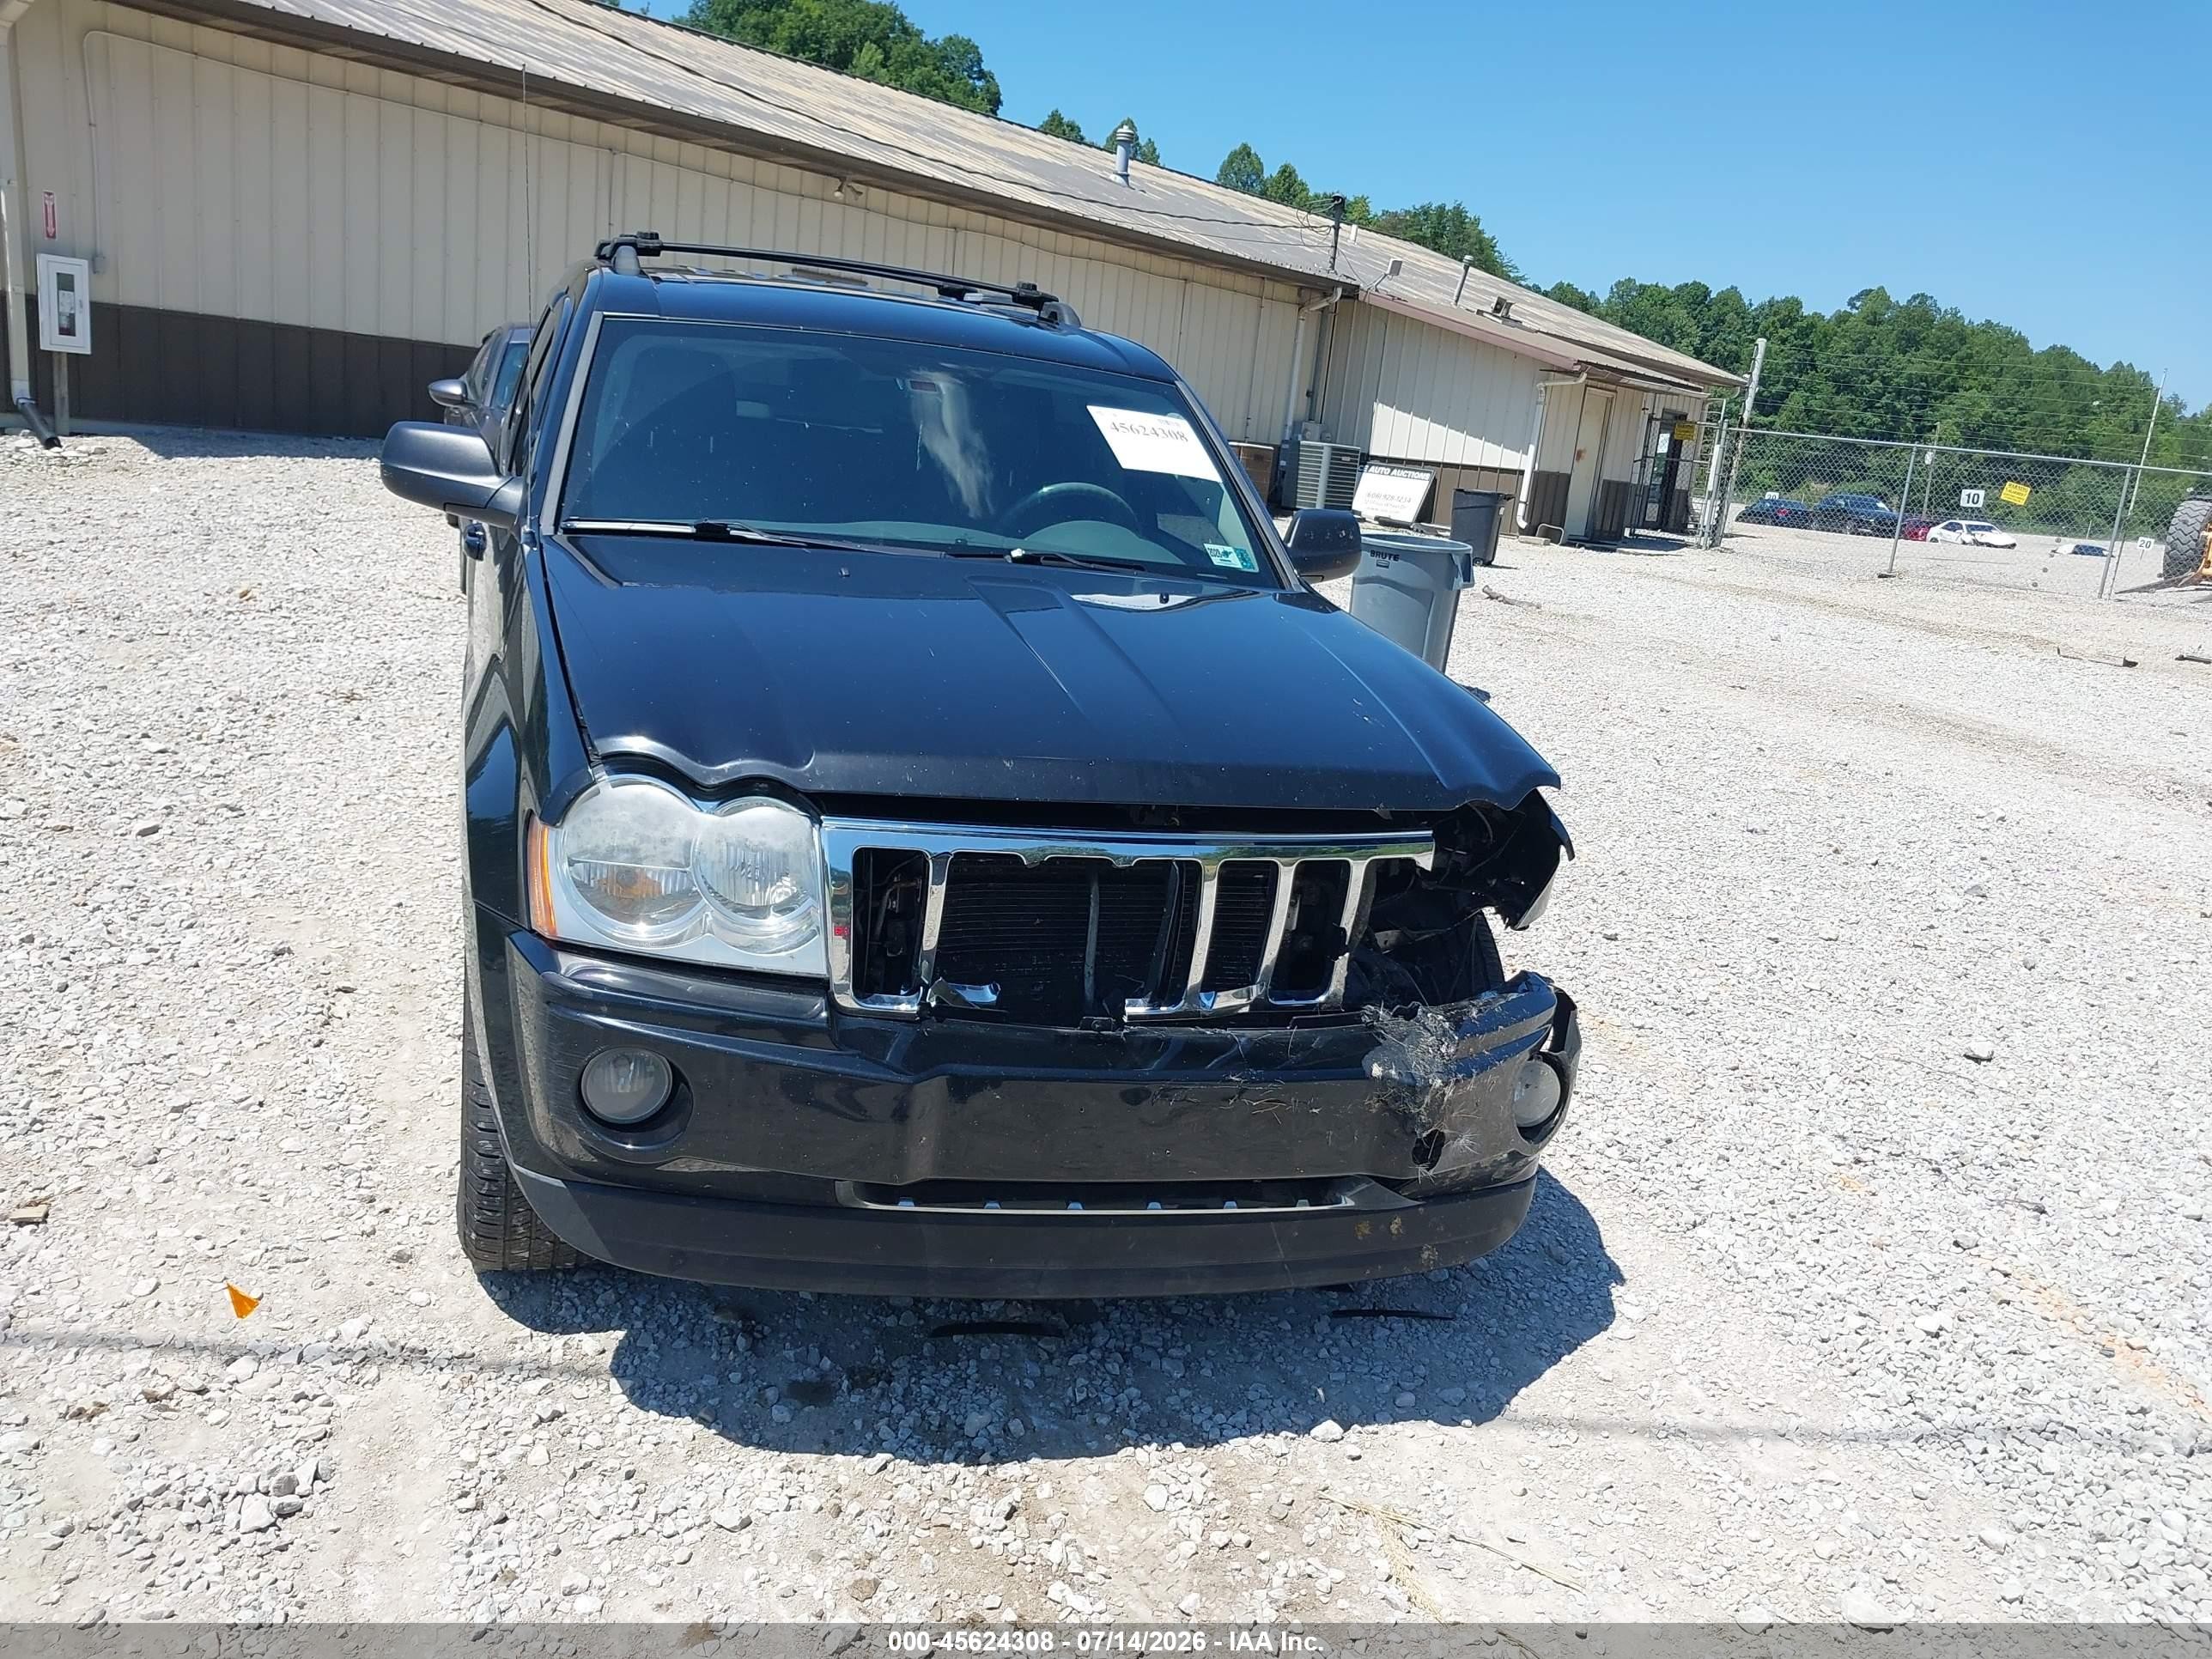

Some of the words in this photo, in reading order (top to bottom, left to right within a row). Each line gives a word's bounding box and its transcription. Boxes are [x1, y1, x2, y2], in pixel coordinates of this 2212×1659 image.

[1110, 421, 1188, 442] 45624308
[1369, 465, 1391, 475] AUTO
[1390, 469, 1431, 481] AUCTIONS
[1965, 492, 1980, 505] 10
[2138, 539, 2152, 549] 20
[1370, 550, 1400, 562] BRUTE
